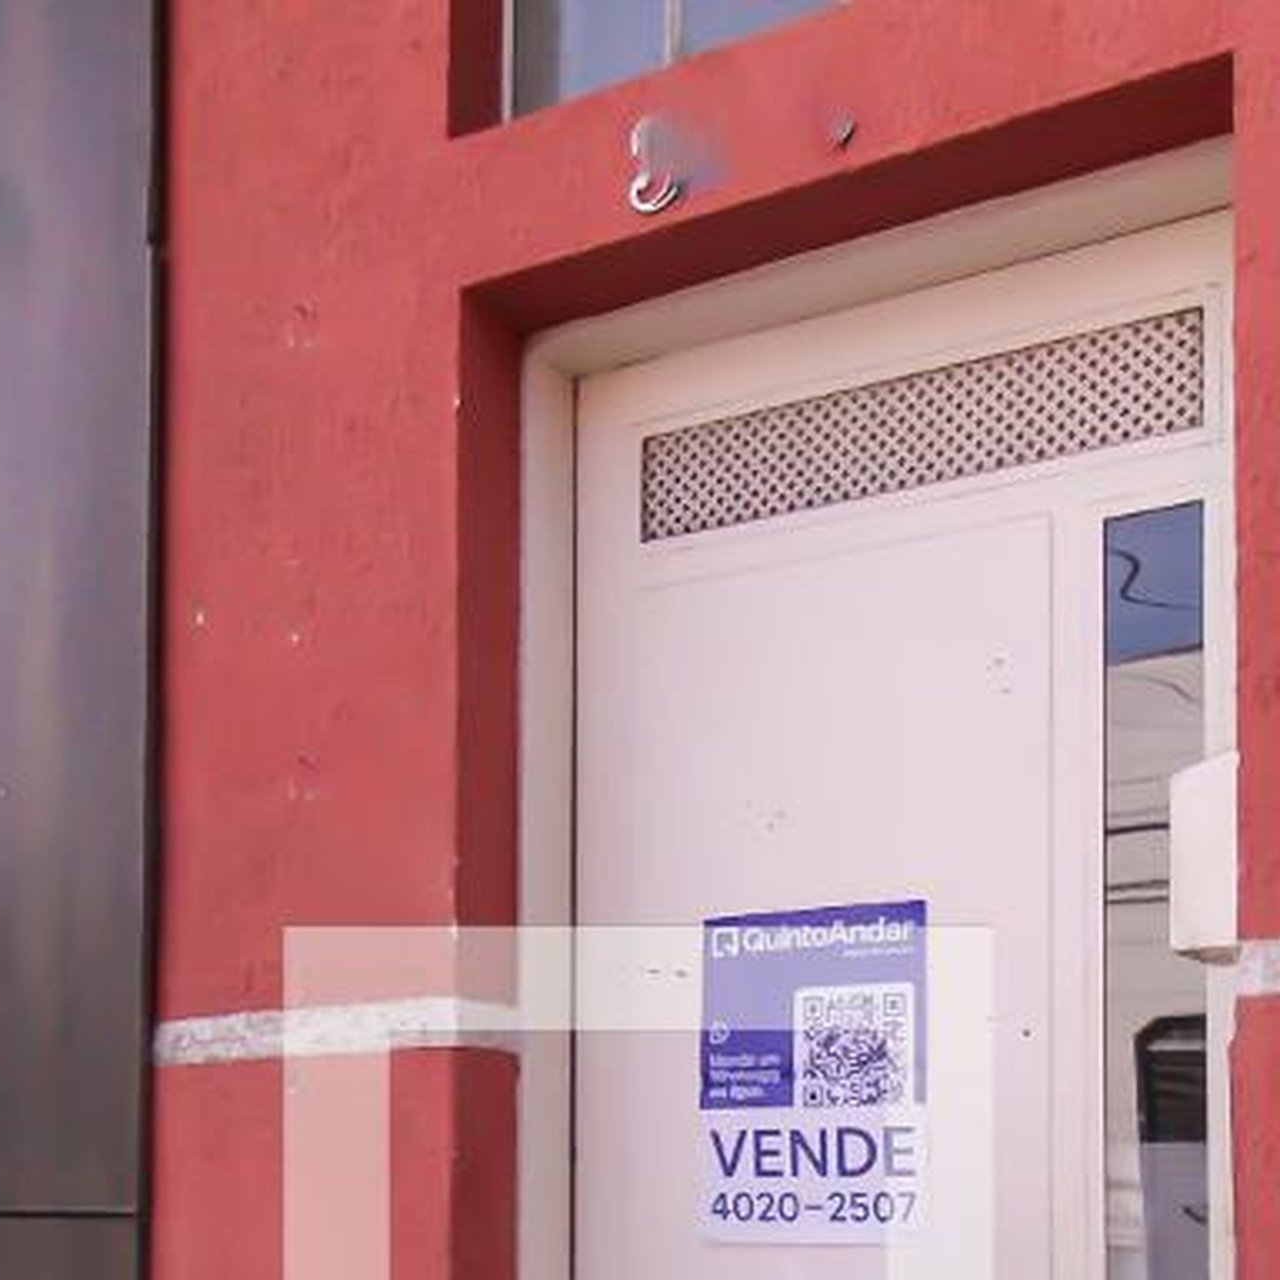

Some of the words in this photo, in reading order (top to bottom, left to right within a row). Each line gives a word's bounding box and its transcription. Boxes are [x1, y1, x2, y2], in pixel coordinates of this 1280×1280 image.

[742, 917, 911, 953] QuintoAndar
[709, 1125, 917, 1179] VENDE
[710, 1191, 917, 1224] 4020-2507
